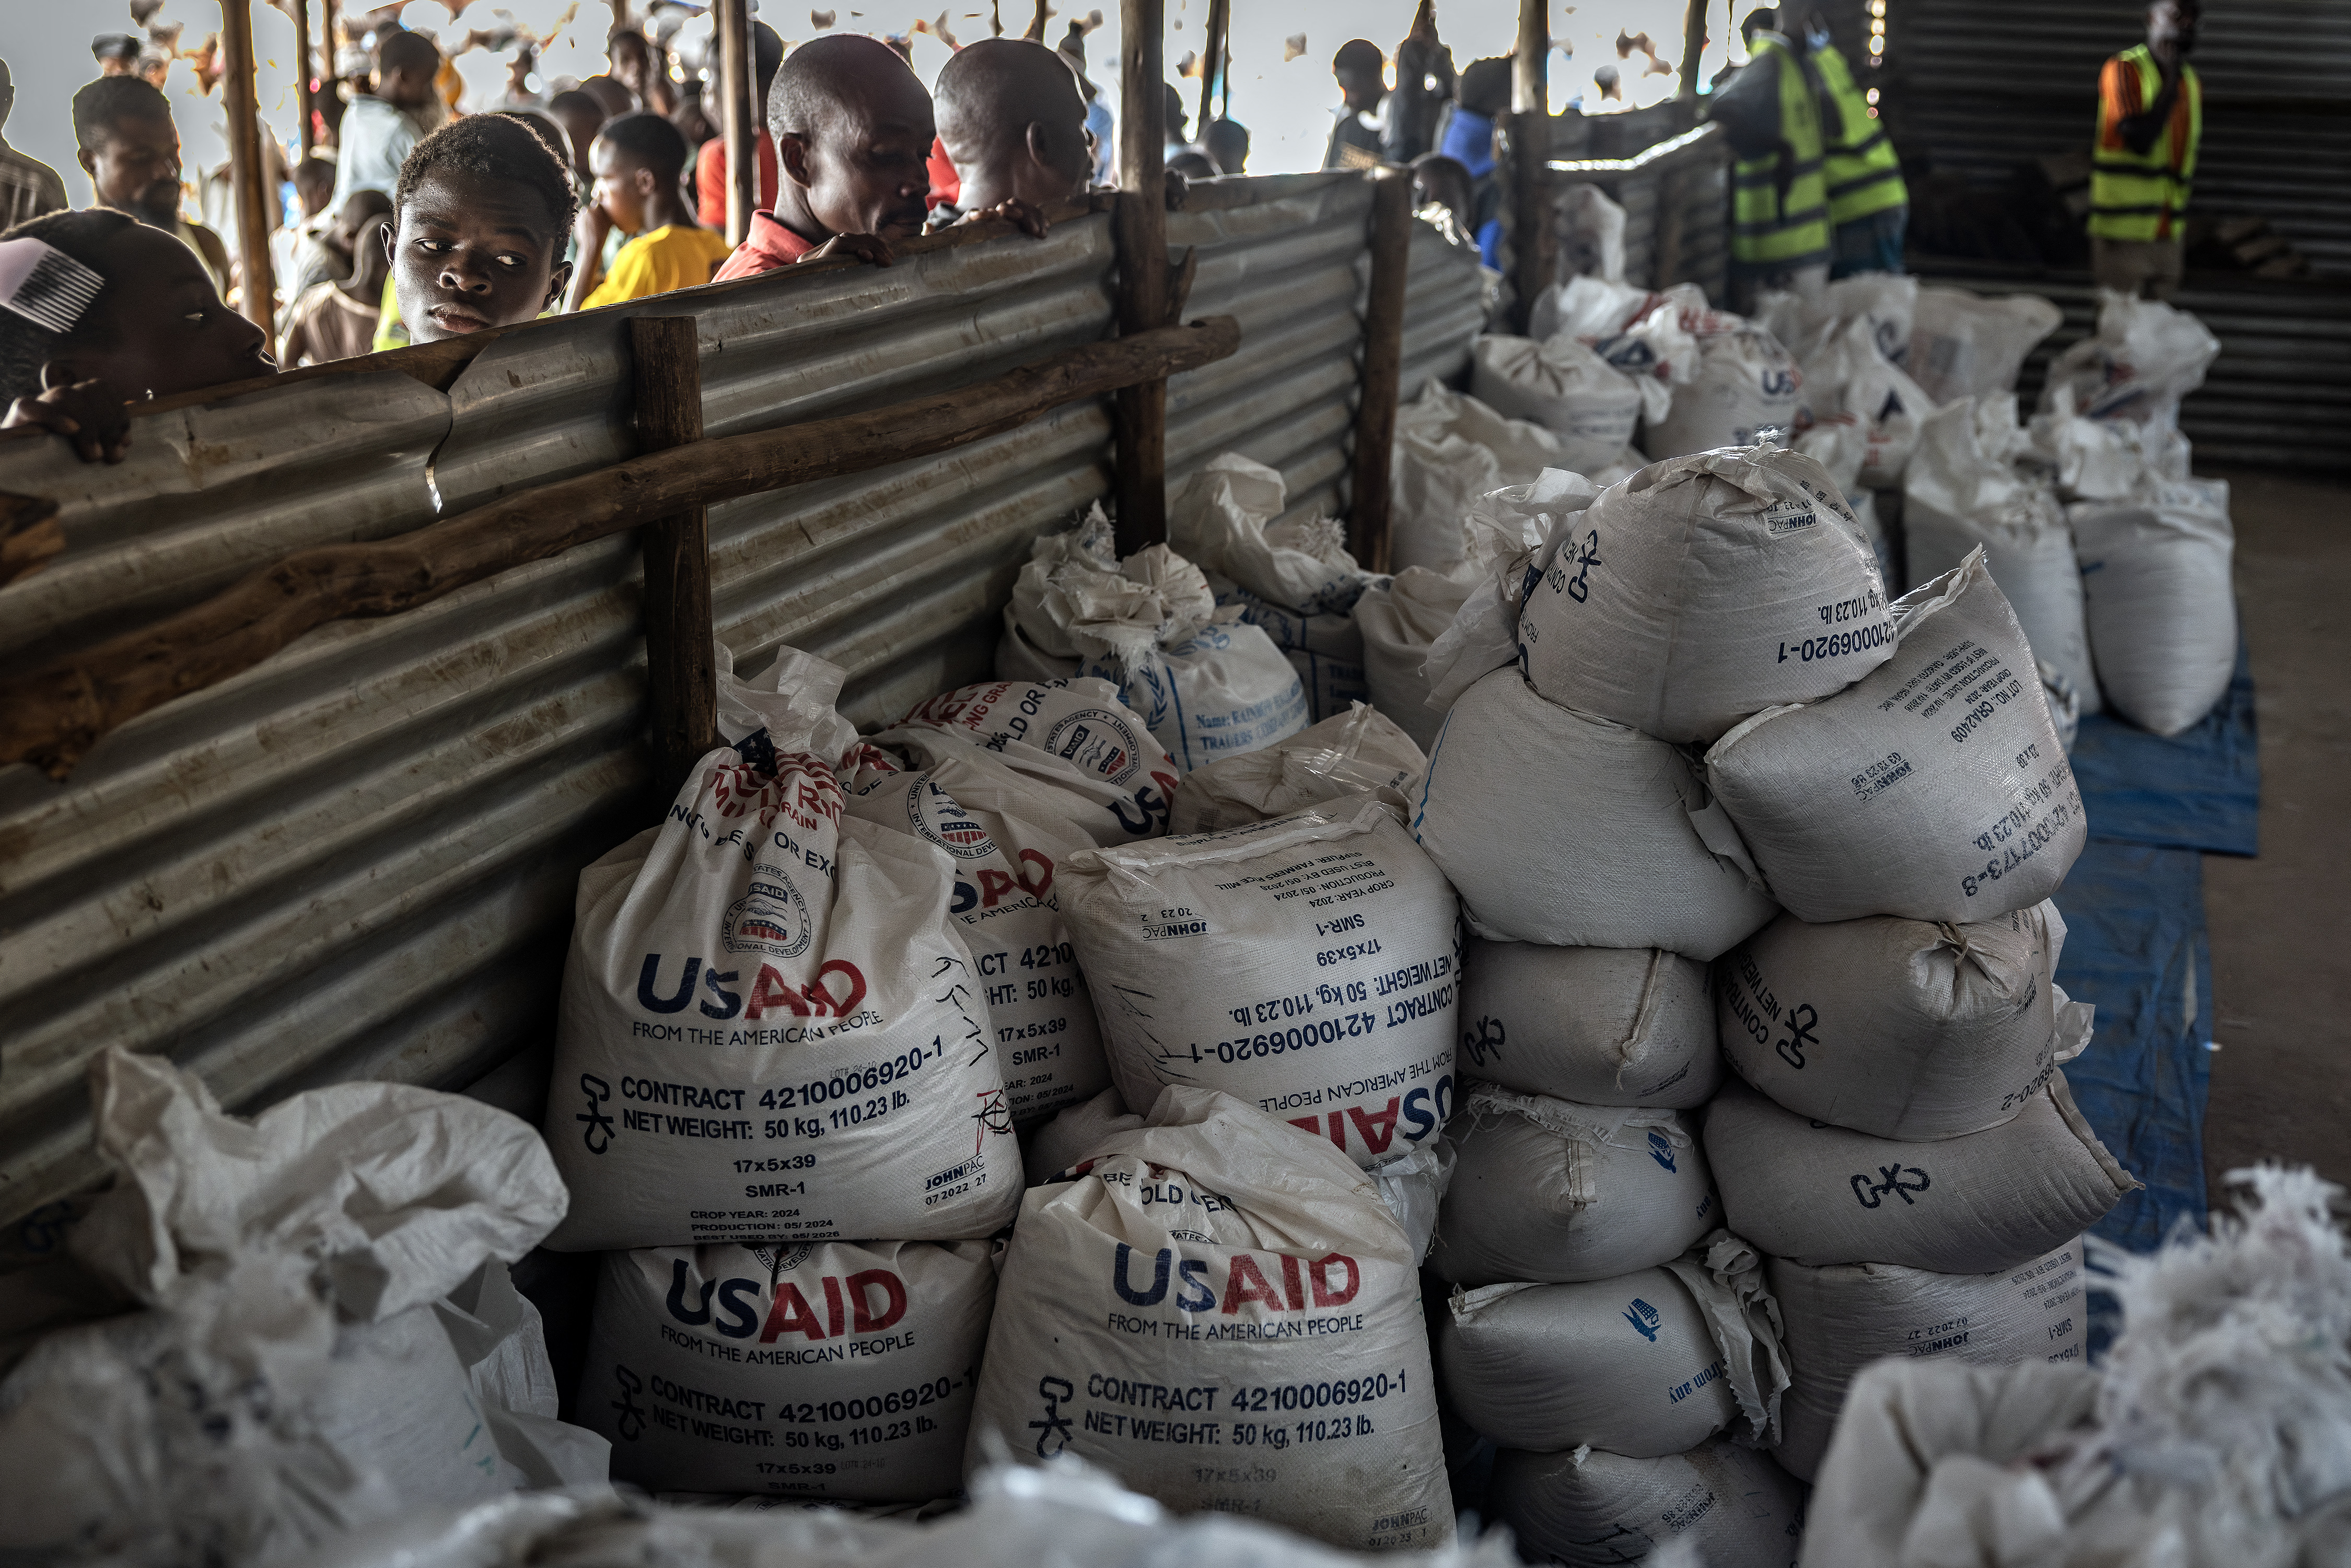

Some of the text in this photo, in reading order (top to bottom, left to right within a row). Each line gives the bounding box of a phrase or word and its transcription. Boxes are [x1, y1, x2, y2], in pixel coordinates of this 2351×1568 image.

[1768, 514, 1817, 532] JOHNPAC
[1818, 605, 1832, 624] lb.
[1835, 599, 1868, 622] 110.23
[2006, 679, 2023, 696] LOT
[1064, 711, 1099, 725] AGENCY
[1951, 701, 1995, 743] CRA2409
[774, 831, 801, 860] OR
[912, 812, 975, 857] INTERNATIONAL
[1214, 852, 1363, 891] SUPPLIER: FARMERS RICE MILL
[1300, 870, 1320, 880] BY:
[1321, 864, 1349, 876] USED
[1351, 860, 1375, 872] BEST
[1260, 881, 1280, 891] 2026
[1318, 869, 1386, 893] PRODUCTION:
[782, 876, 806, 914] AGENCY
[1273, 889, 1299, 902] 2024
[1309, 879, 1394, 909] CROP YEAR: 2024
[1143, 922, 1207, 939] JOHNPAC
[1316, 913, 1365, 937] SMR-1
[768, 927, 809, 956] DEVELOPMENT
[1317, 938, 1382, 967] 17x5x39
[1027, 977, 1048, 1000] 50
[1229, 954, 1452, 1027] NET WEIGHT: 50 kg, 110.23 lb.
[1756, 986, 1782, 1022] NET
[633, 1011, 884, 1046] FROM THE AMERICAN PEOPLE
[997, 1017, 1067, 1042] 17x5x39
[1191, 983, 1453, 1064] CONTRACT 4210006920-1
[1011, 1043, 1061, 1065] SMR-1
[621, 1035, 943, 1111] CONTRACT 4210006920-1
[1030, 1073, 1053, 1086] 2024
[1259, 1047, 1452, 1111] FROM THE AMERICAN PEOPLE
[623, 1089, 911, 1140] NET WEIGHT: 50 kg, 110.23 lb.
[734, 1154, 817, 1174] 17x5x39
[925, 1155, 985, 1190] JOHNPAC
[745, 1181, 806, 1199] SMR-1
[925, 1173, 986, 1205] 07 2022 27
[690, 1209, 800, 1219] CROP YEAR: 2024
[691, 1223, 781, 1232] PRODUCTION:
[805, 1219, 833, 1229] 2024
[812, 1230, 840, 1239] 2026
[1113, 1242, 1360, 1314] USAID
[666, 1258, 908, 1343] USAID
[1108, 1314, 1363, 1340] FROM THE AMERICAN PEOPLE
[1907, 1329, 1922, 1340] 27
[1927, 1321, 1953, 1336] 2022
[2049, 1318, 2073, 1341] SMR-1
[661, 1324, 915, 1366] FROM THE AMERICAN PEOPLE
[1909, 1332, 1969, 1357] JOHNPAC
[651, 1366, 975, 1424] CONTRACT 4210006920-1
[1087, 1368, 1406, 1412] CONTRACT 4210006920-1
[1668, 1381, 1693, 1406] any
[653, 1404, 938, 1451] NET WEIGHT: 50 kg, 110.23 lb.
[1084, 1410, 1375, 1450] NET WEIGHT: 50 kg, 110.23 lb.
[755, 1462, 836, 1474] 17x5x39
[768, 1481, 826, 1491] SMR-1
[1372, 1507, 1427, 1531] JOHNPAC
